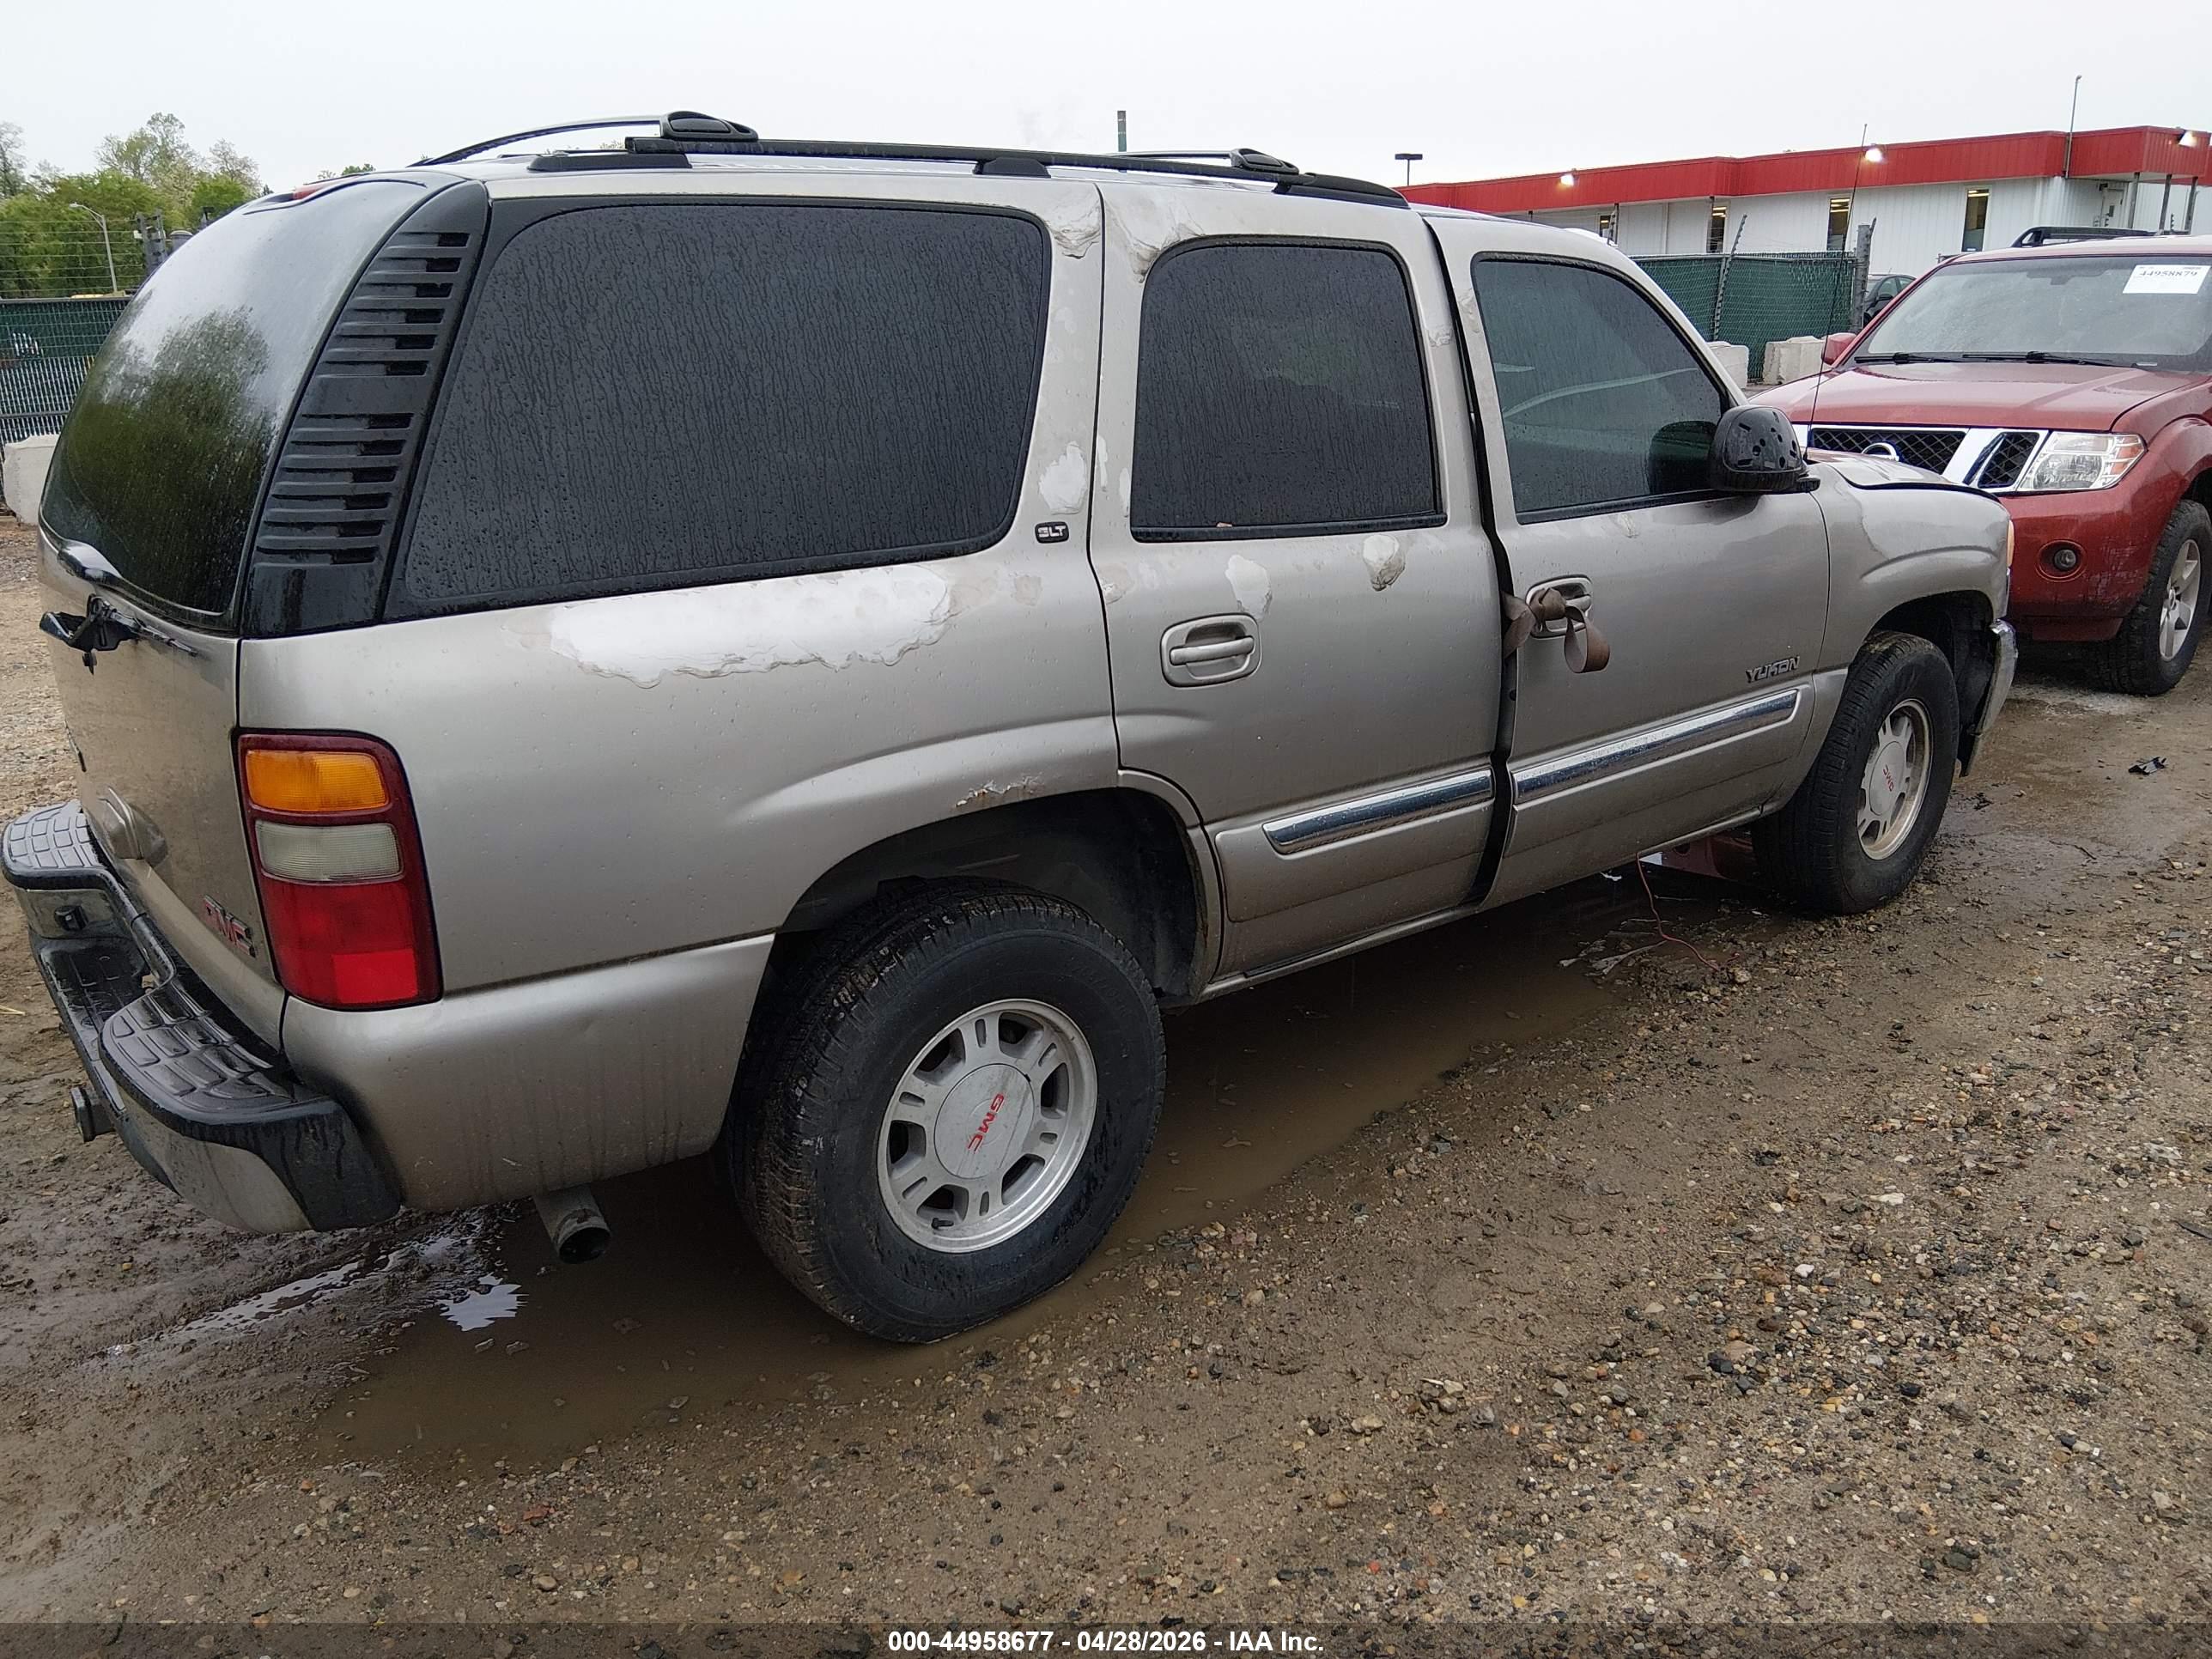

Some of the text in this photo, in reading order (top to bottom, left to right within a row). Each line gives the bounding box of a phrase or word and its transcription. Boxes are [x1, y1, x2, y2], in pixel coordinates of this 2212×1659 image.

[1037, 525, 1066, 538] SLT
[1745, 655, 1800, 684] YUKON
[1882, 764, 1894, 793] GMC
[966, 1092, 1005, 1154] GMC
